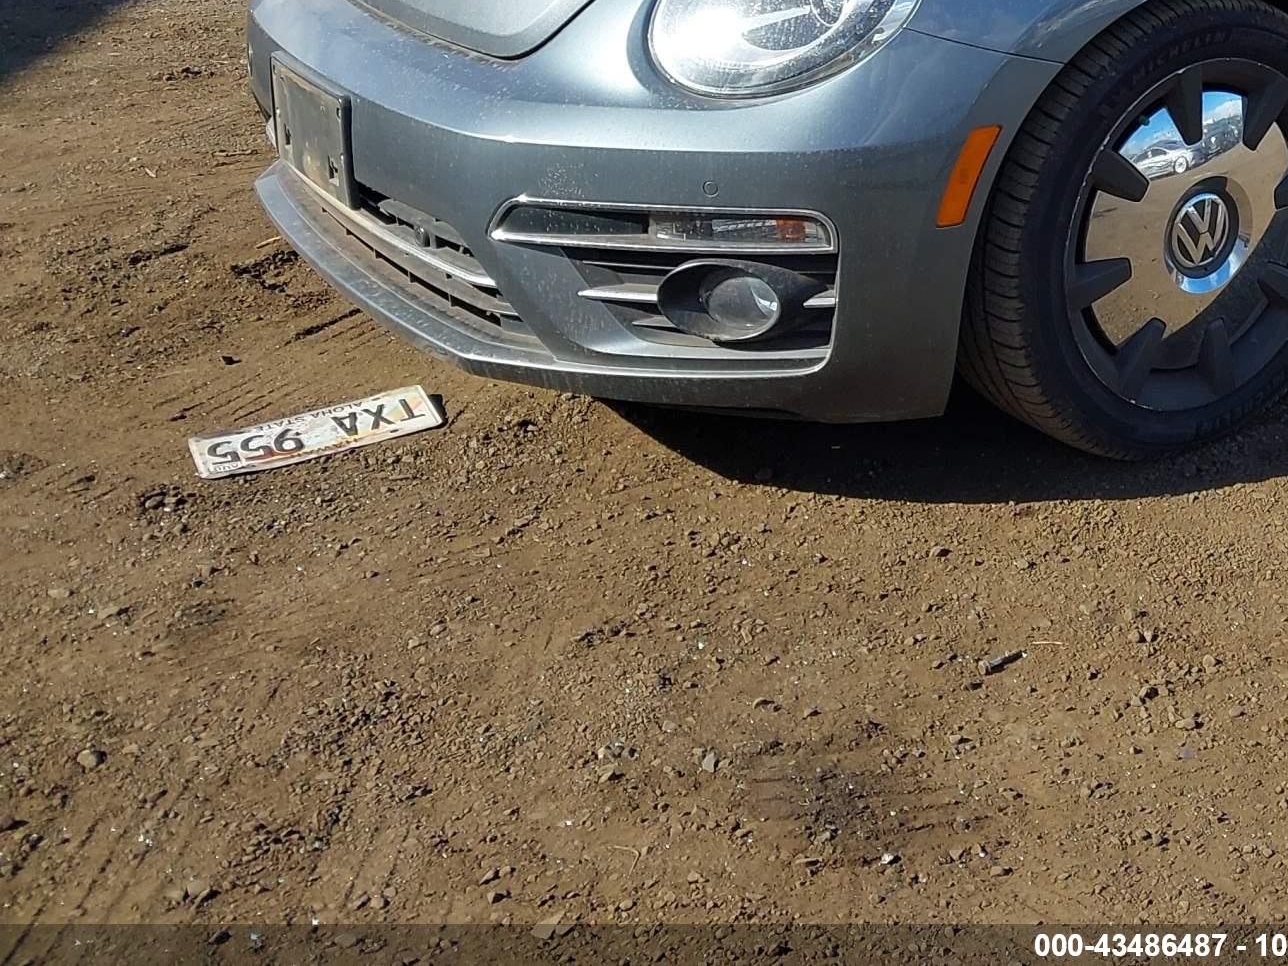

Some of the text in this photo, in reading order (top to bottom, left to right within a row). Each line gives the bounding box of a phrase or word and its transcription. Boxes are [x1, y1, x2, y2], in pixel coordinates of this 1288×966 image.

[206, 398, 425, 466] TXA 955
[256, 401, 362, 432] ALOHA STATE
